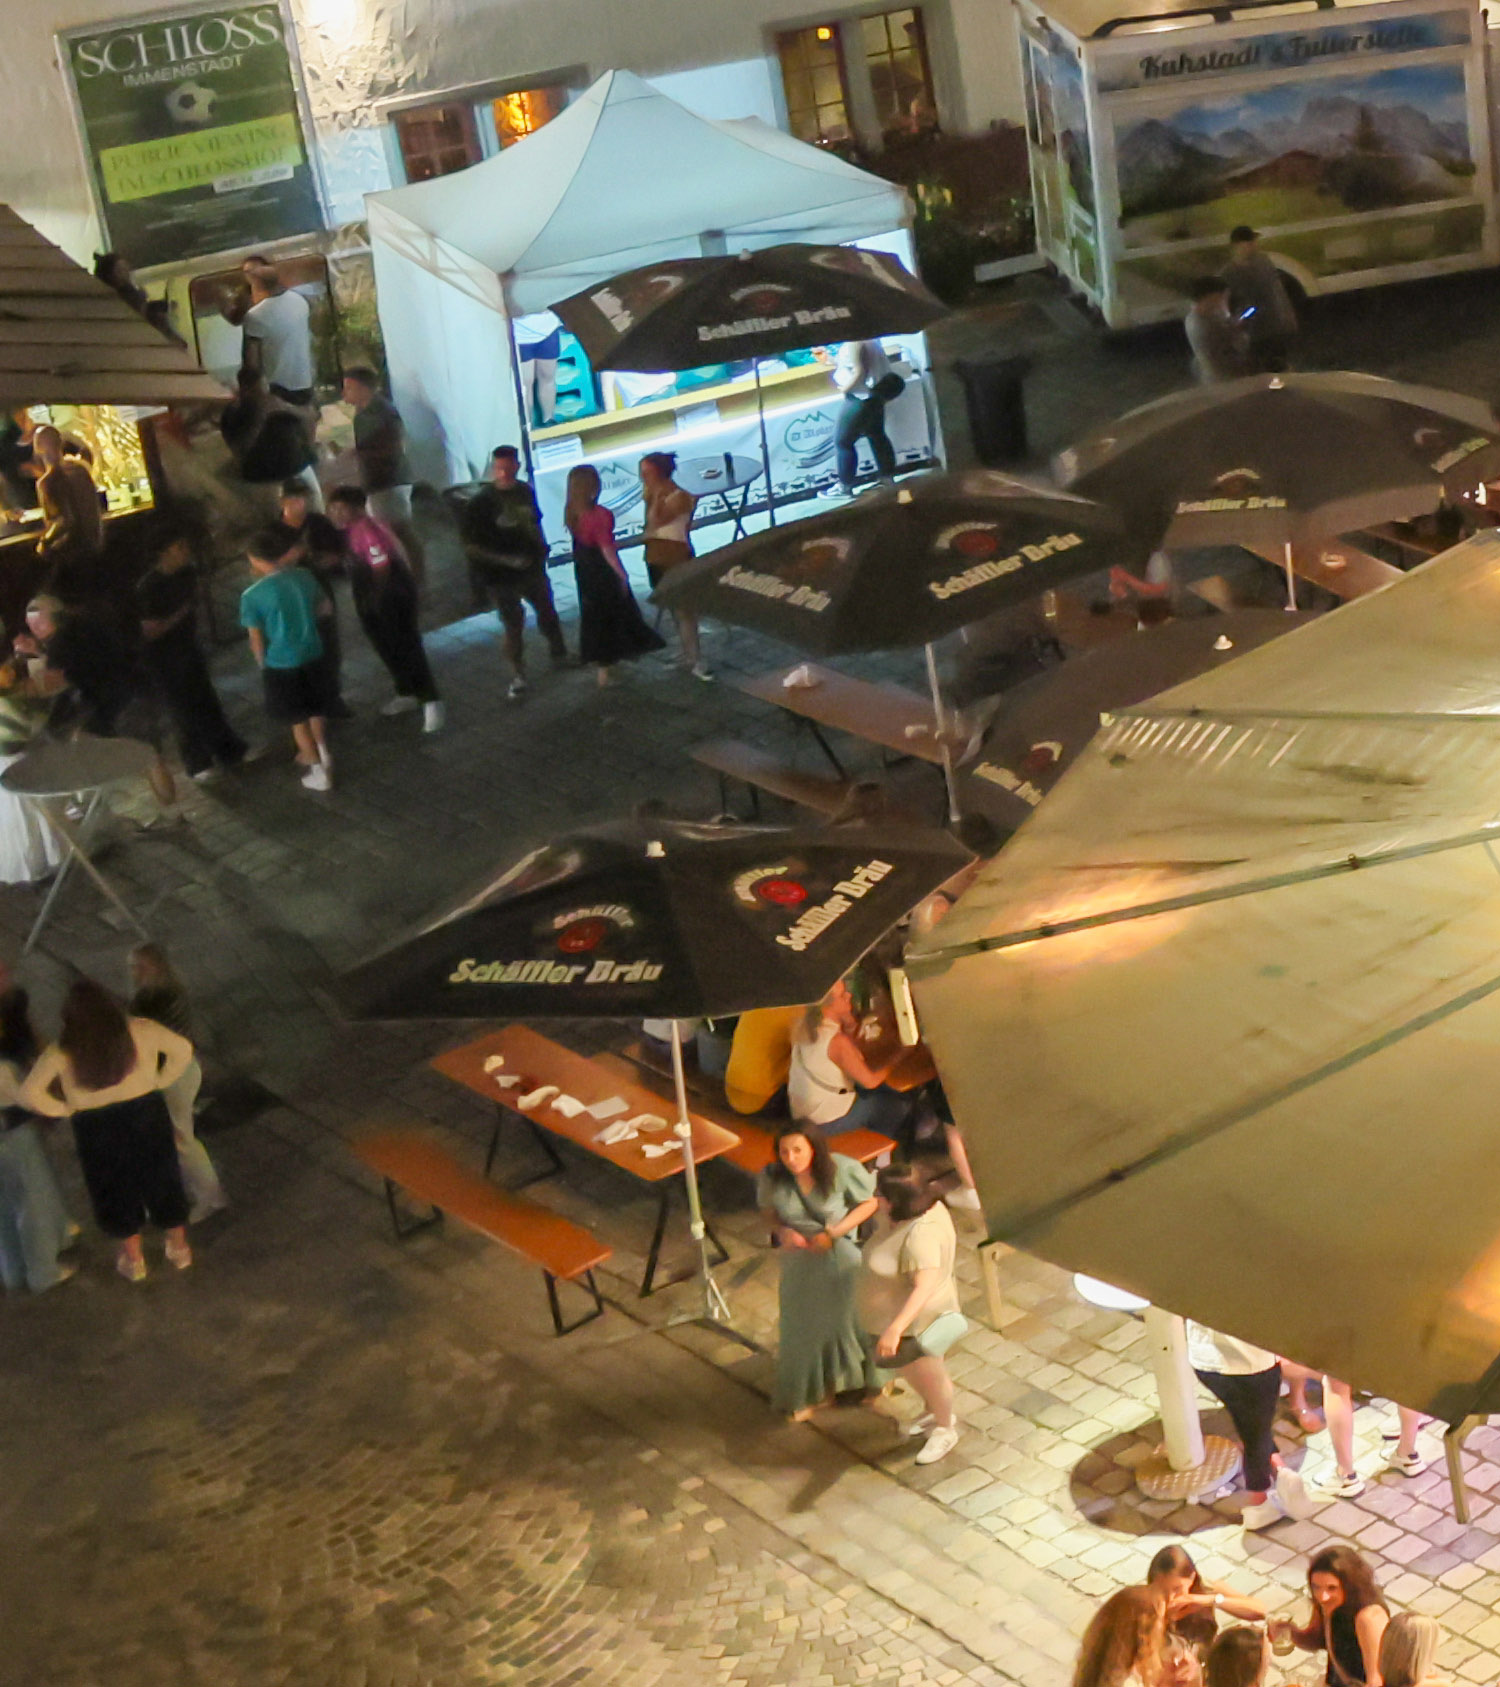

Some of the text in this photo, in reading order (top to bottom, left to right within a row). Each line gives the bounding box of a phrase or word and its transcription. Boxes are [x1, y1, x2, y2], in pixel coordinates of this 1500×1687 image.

[77, 9, 280, 77] SCHLOSS
[123, 53, 244, 87] IMMENSTADT
[449, 958, 664, 985] Schäffler Bräu
